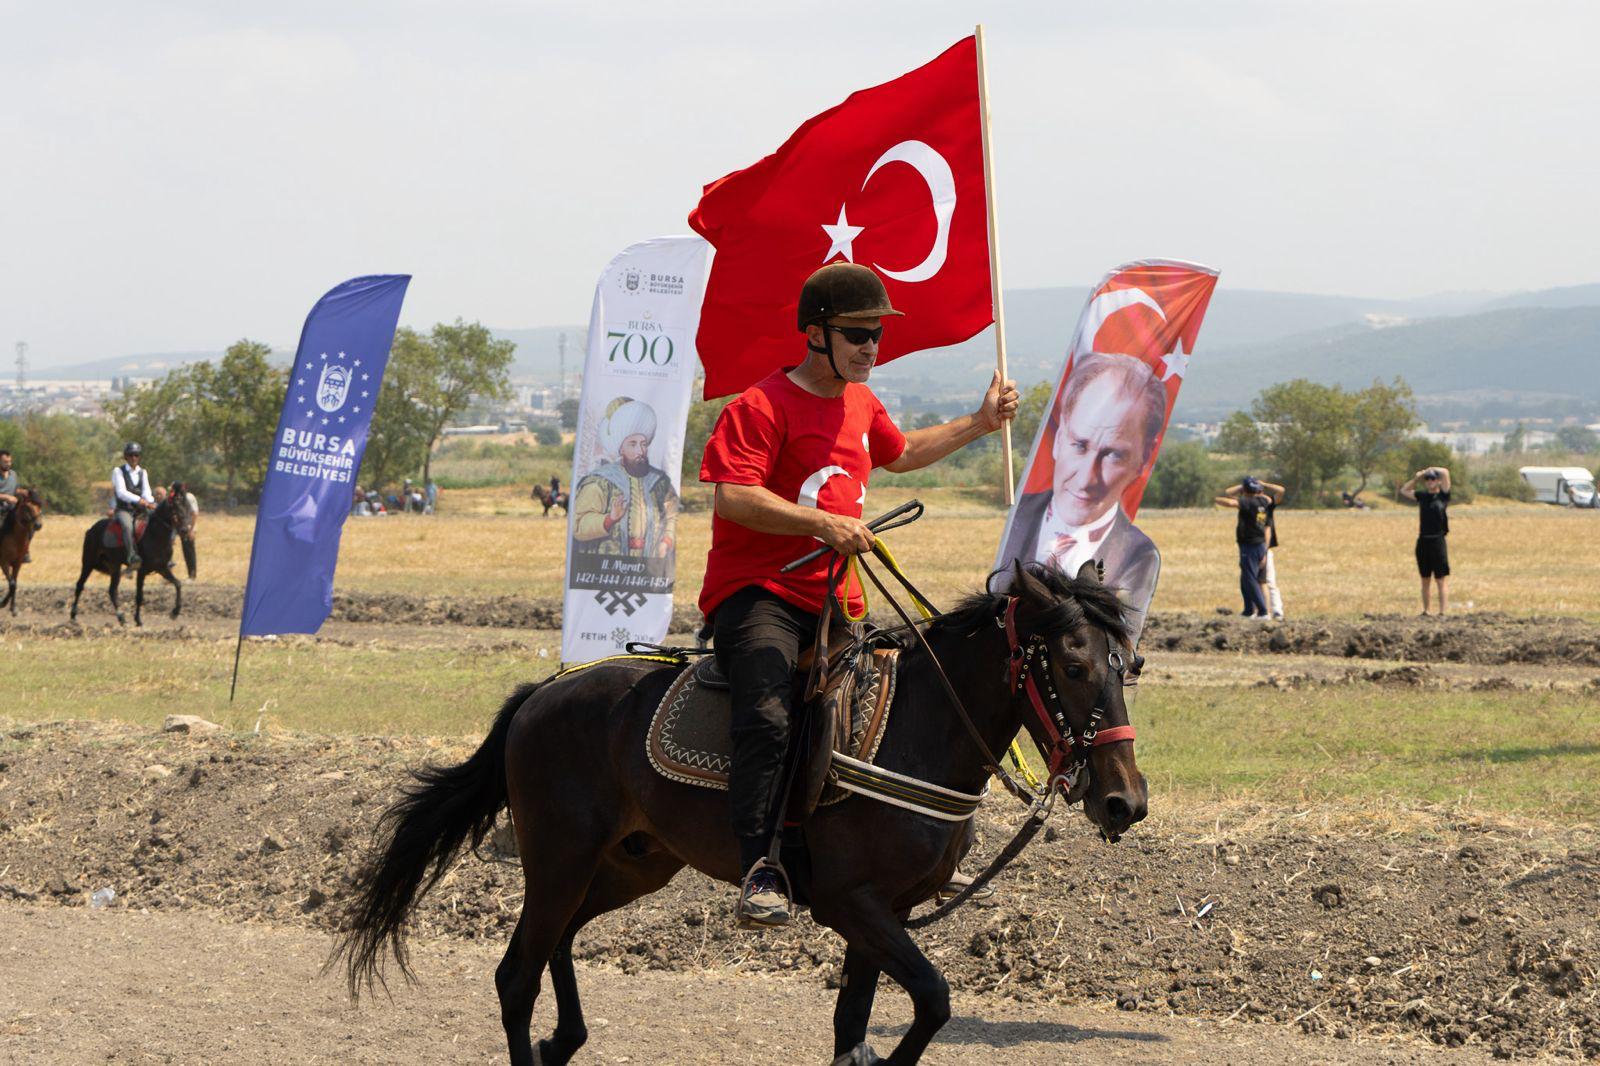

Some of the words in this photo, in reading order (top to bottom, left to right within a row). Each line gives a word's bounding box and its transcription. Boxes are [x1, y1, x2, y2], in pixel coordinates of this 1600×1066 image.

[650, 274, 685, 283] BURSA
[628, 320, 663, 332] BURSA
[607, 331, 674, 366] 700
[282, 427, 355, 456] BURSA
[279, 446, 353, 469] BÜYÜKŞEHİR
[275, 460, 352, 483] BELEDİYESİ
[576, 572, 620, 585] 1421-1444
